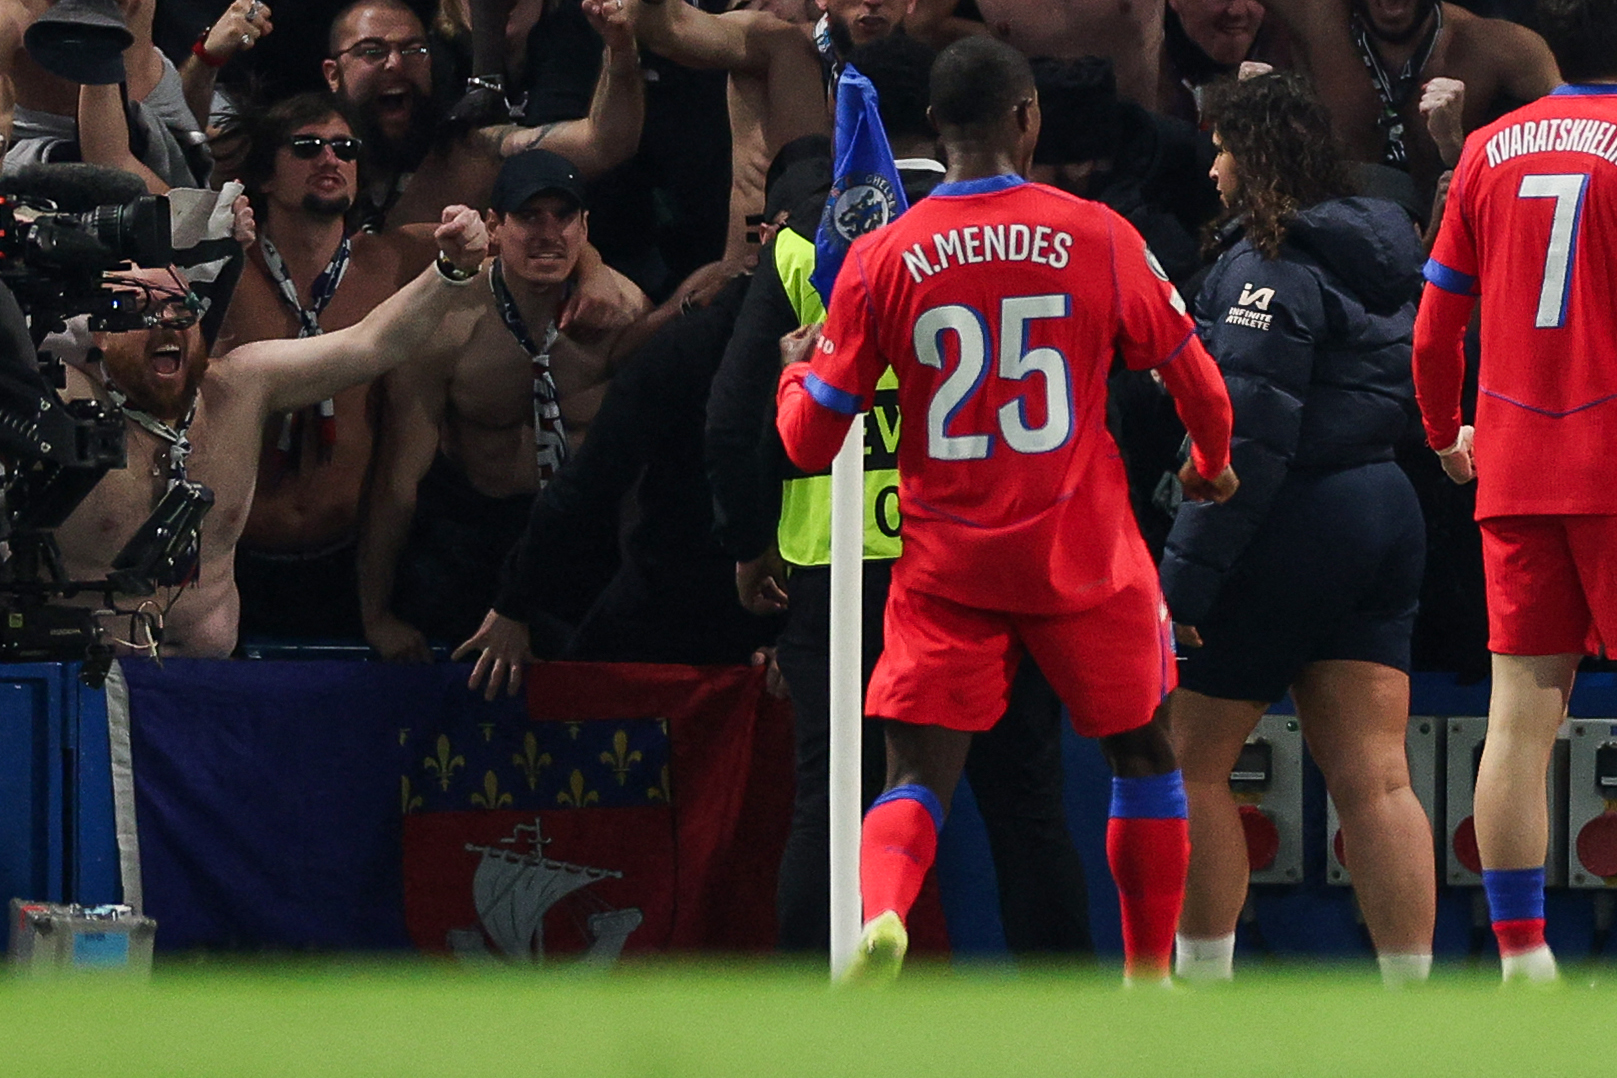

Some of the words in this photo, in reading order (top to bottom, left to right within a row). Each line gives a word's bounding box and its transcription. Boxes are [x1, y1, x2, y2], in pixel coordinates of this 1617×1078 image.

[901, 224, 1073, 284] N.MENDES
[1517, 173, 1590, 329] 7
[1225, 315, 1271, 331] ATHLETE
[1228, 306, 1274, 322] INFINITE
[912, 293, 1073, 462] 25
